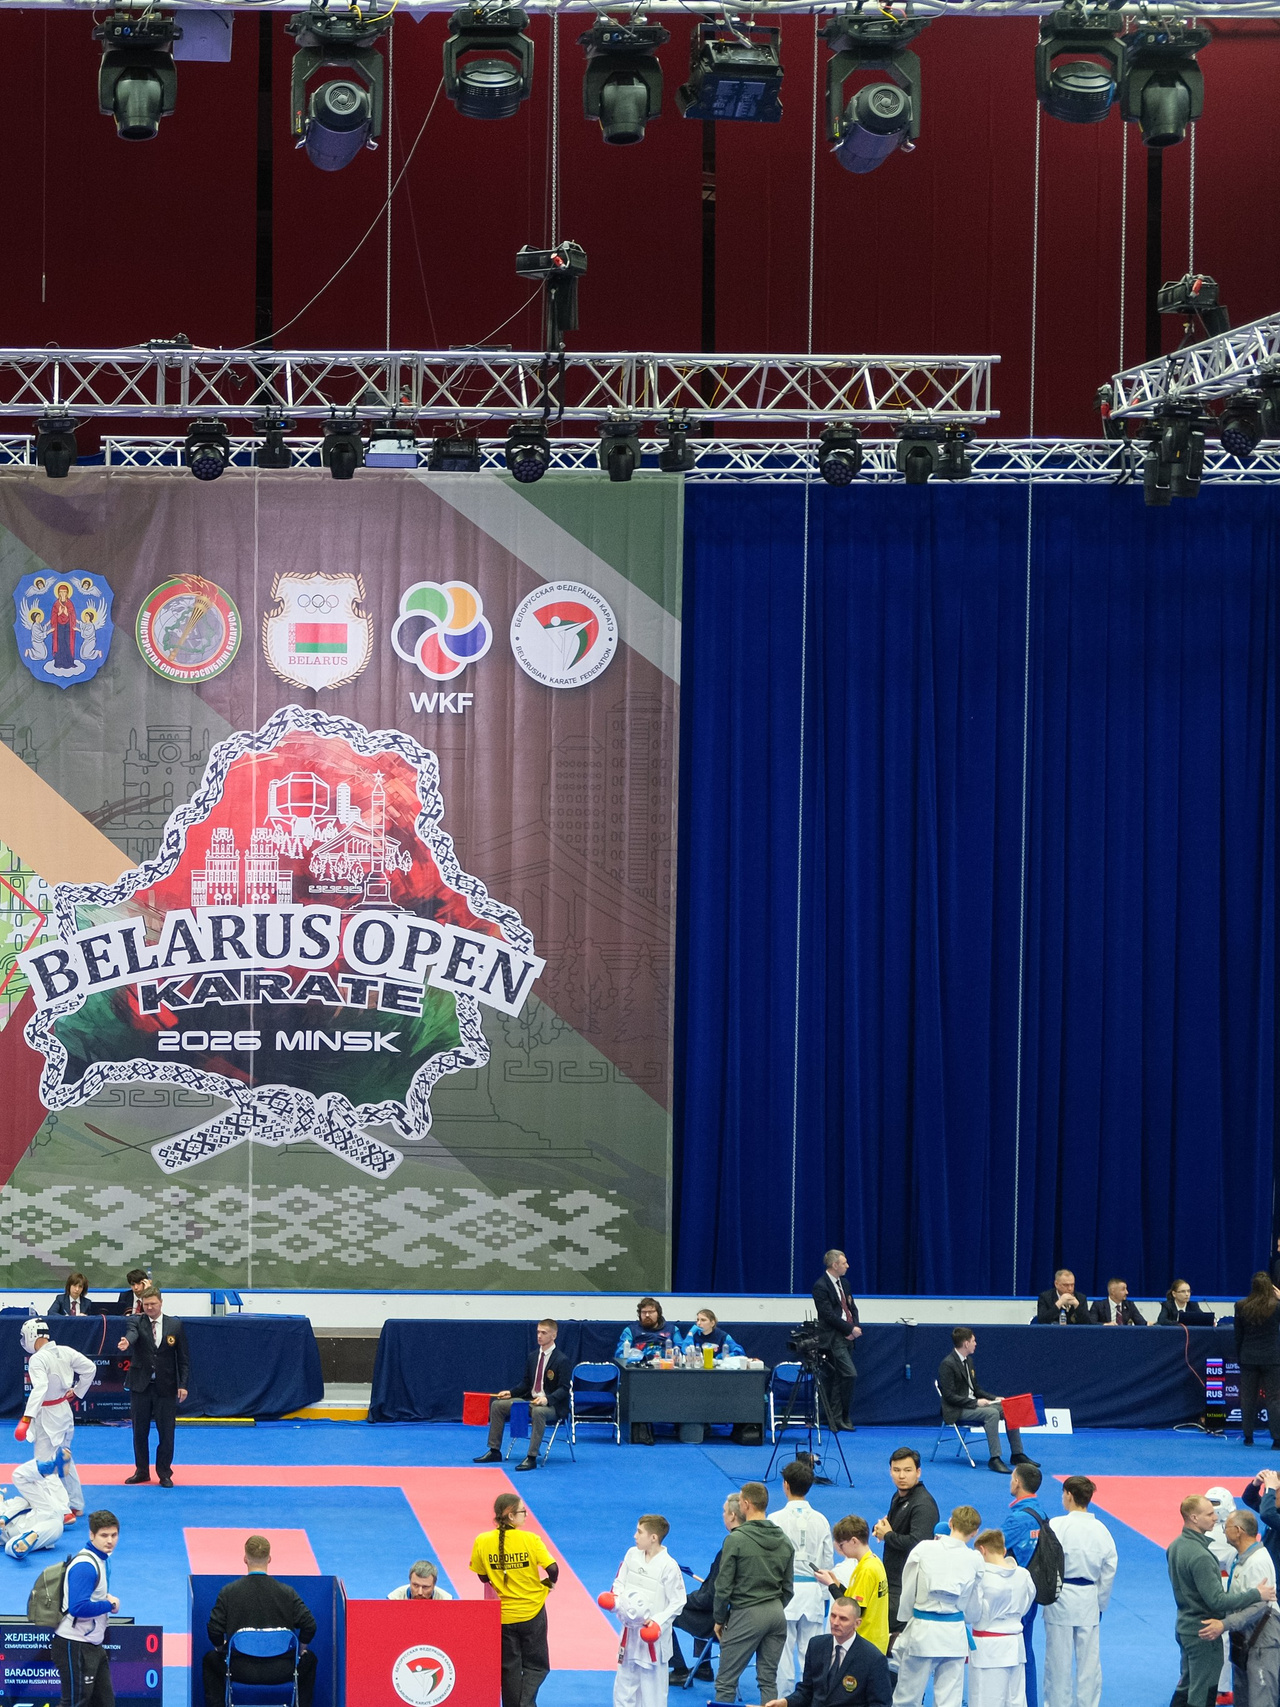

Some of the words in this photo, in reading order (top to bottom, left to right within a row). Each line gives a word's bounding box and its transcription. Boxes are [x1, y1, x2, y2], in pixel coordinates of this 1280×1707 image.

[514, 586, 555, 628] БЕЛОРУССКАЯ
[556, 584, 601, 605] ФЕДЕРАЦИЯ
[599, 604, 614, 632] КАРАТЭ
[160, 663, 189, 679] СПОРТУ
[226, 611, 238, 651] БЕЛАРУСЬ
[288, 655, 348, 666] BELARUS
[515, 645, 548, 681] BELARUSIAN
[549, 677, 578, 685] KARATE
[579, 647, 612, 681] FEDERATION
[409, 692, 474, 713] WKF
[28, 911, 335, 1003] BELARUS
[351, 912, 535, 1007] OPEN
[138, 970, 426, 1017] KARATE
[157, 1030, 262, 1052] 2026
[275, 1030, 403, 1054] MINSK
[1206, 1367, 1223, 1375] RUS
[1206, 1390, 1223, 1398] RUS
[1051, 1416, 1058, 1428] 6
[488, 1552, 529, 1563] ВООНТЕР
[4, 1633, 51, 1642] ЖЕЛЕЗНЯК
[146, 1634, 158, 1653] 0
[145, 1669, 158, 1688] 0
